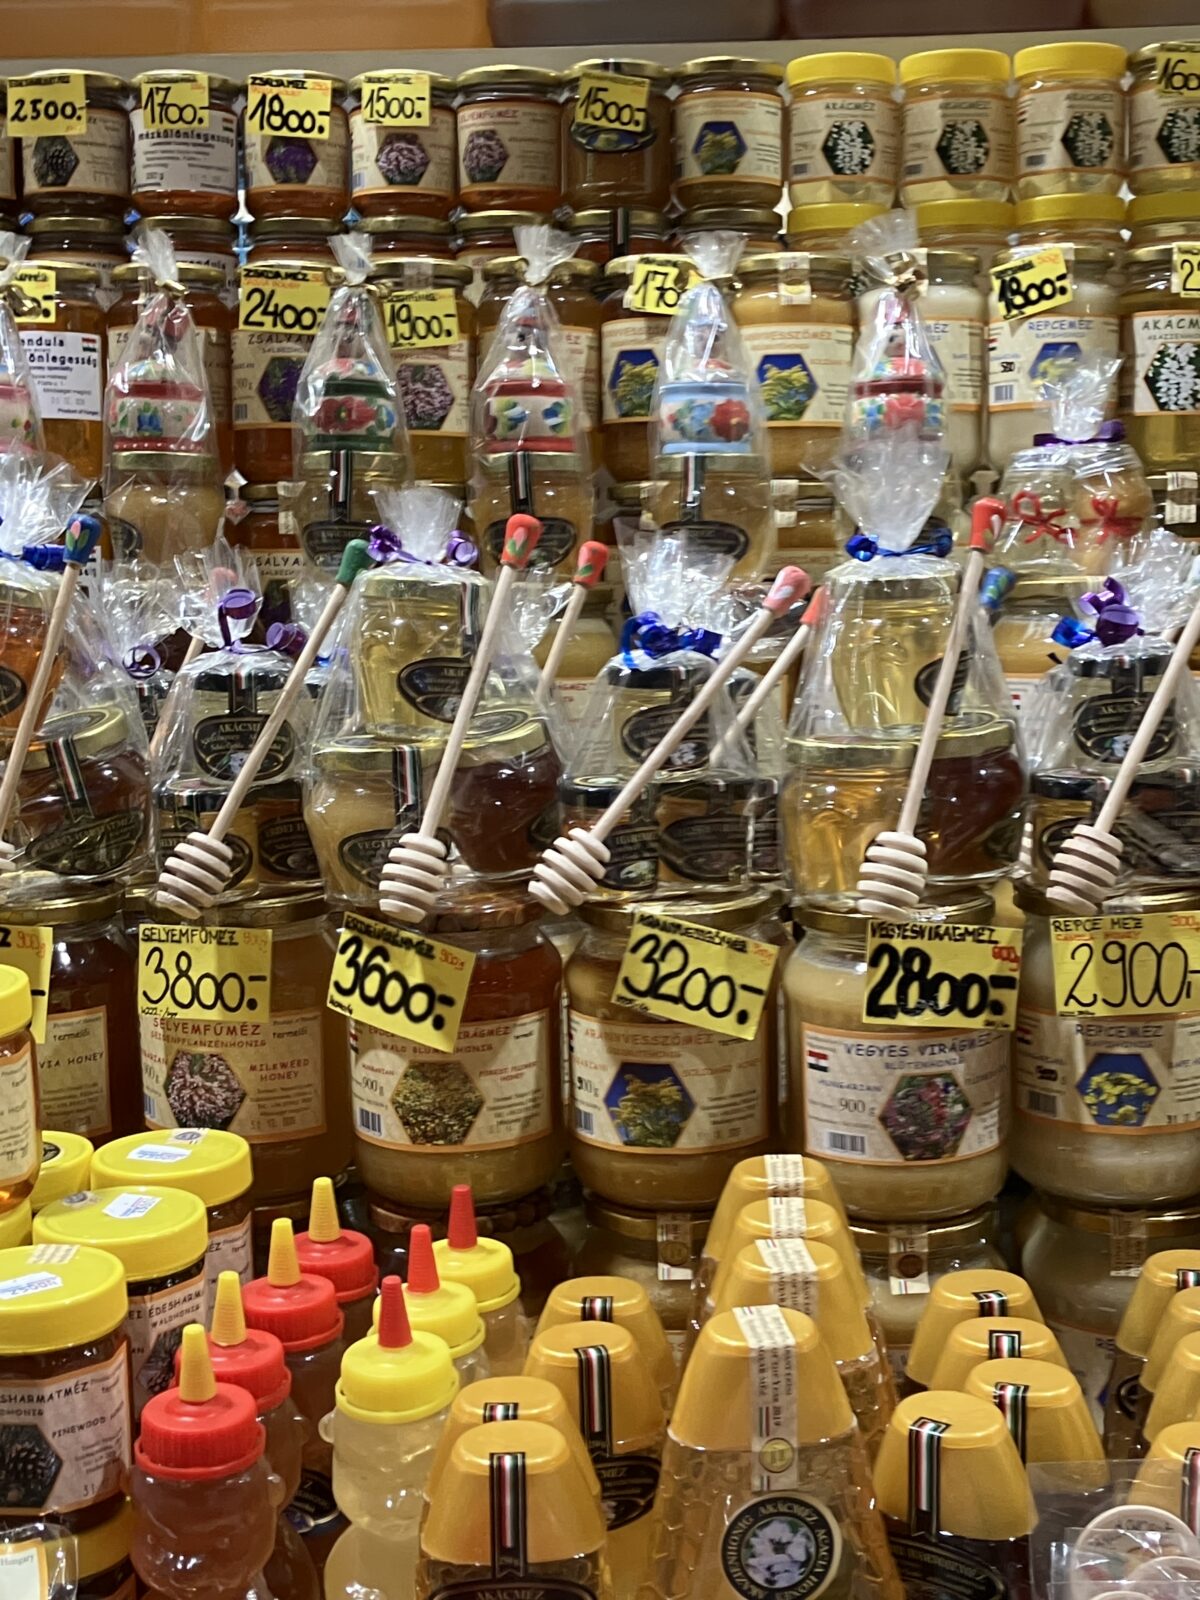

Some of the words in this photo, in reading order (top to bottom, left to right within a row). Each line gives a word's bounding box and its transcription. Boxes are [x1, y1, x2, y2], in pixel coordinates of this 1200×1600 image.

[10, 98, 86, 122] 2500.-
[143, 86, 210, 124] 1700.-
[249, 93, 330, 133] 1800.-
[364, 87, 425, 119] 1500.-
[579, 86, 647, 127] 1500.-
[998, 273, 1068, 316] 1800.-
[387, 304, 457, 340] 1900.-
[142, 946, 267, 1013] 3800.-
[333, 935, 456, 1031] 3600.-
[622, 933, 765, 1025] 3200.-
[866, 943, 1018, 1019] 2800.-
[846, 1042, 910, 1058] VEGYES
[260, 1070, 300, 1082] HONEY
[839, 1098, 866, 1114] 900
